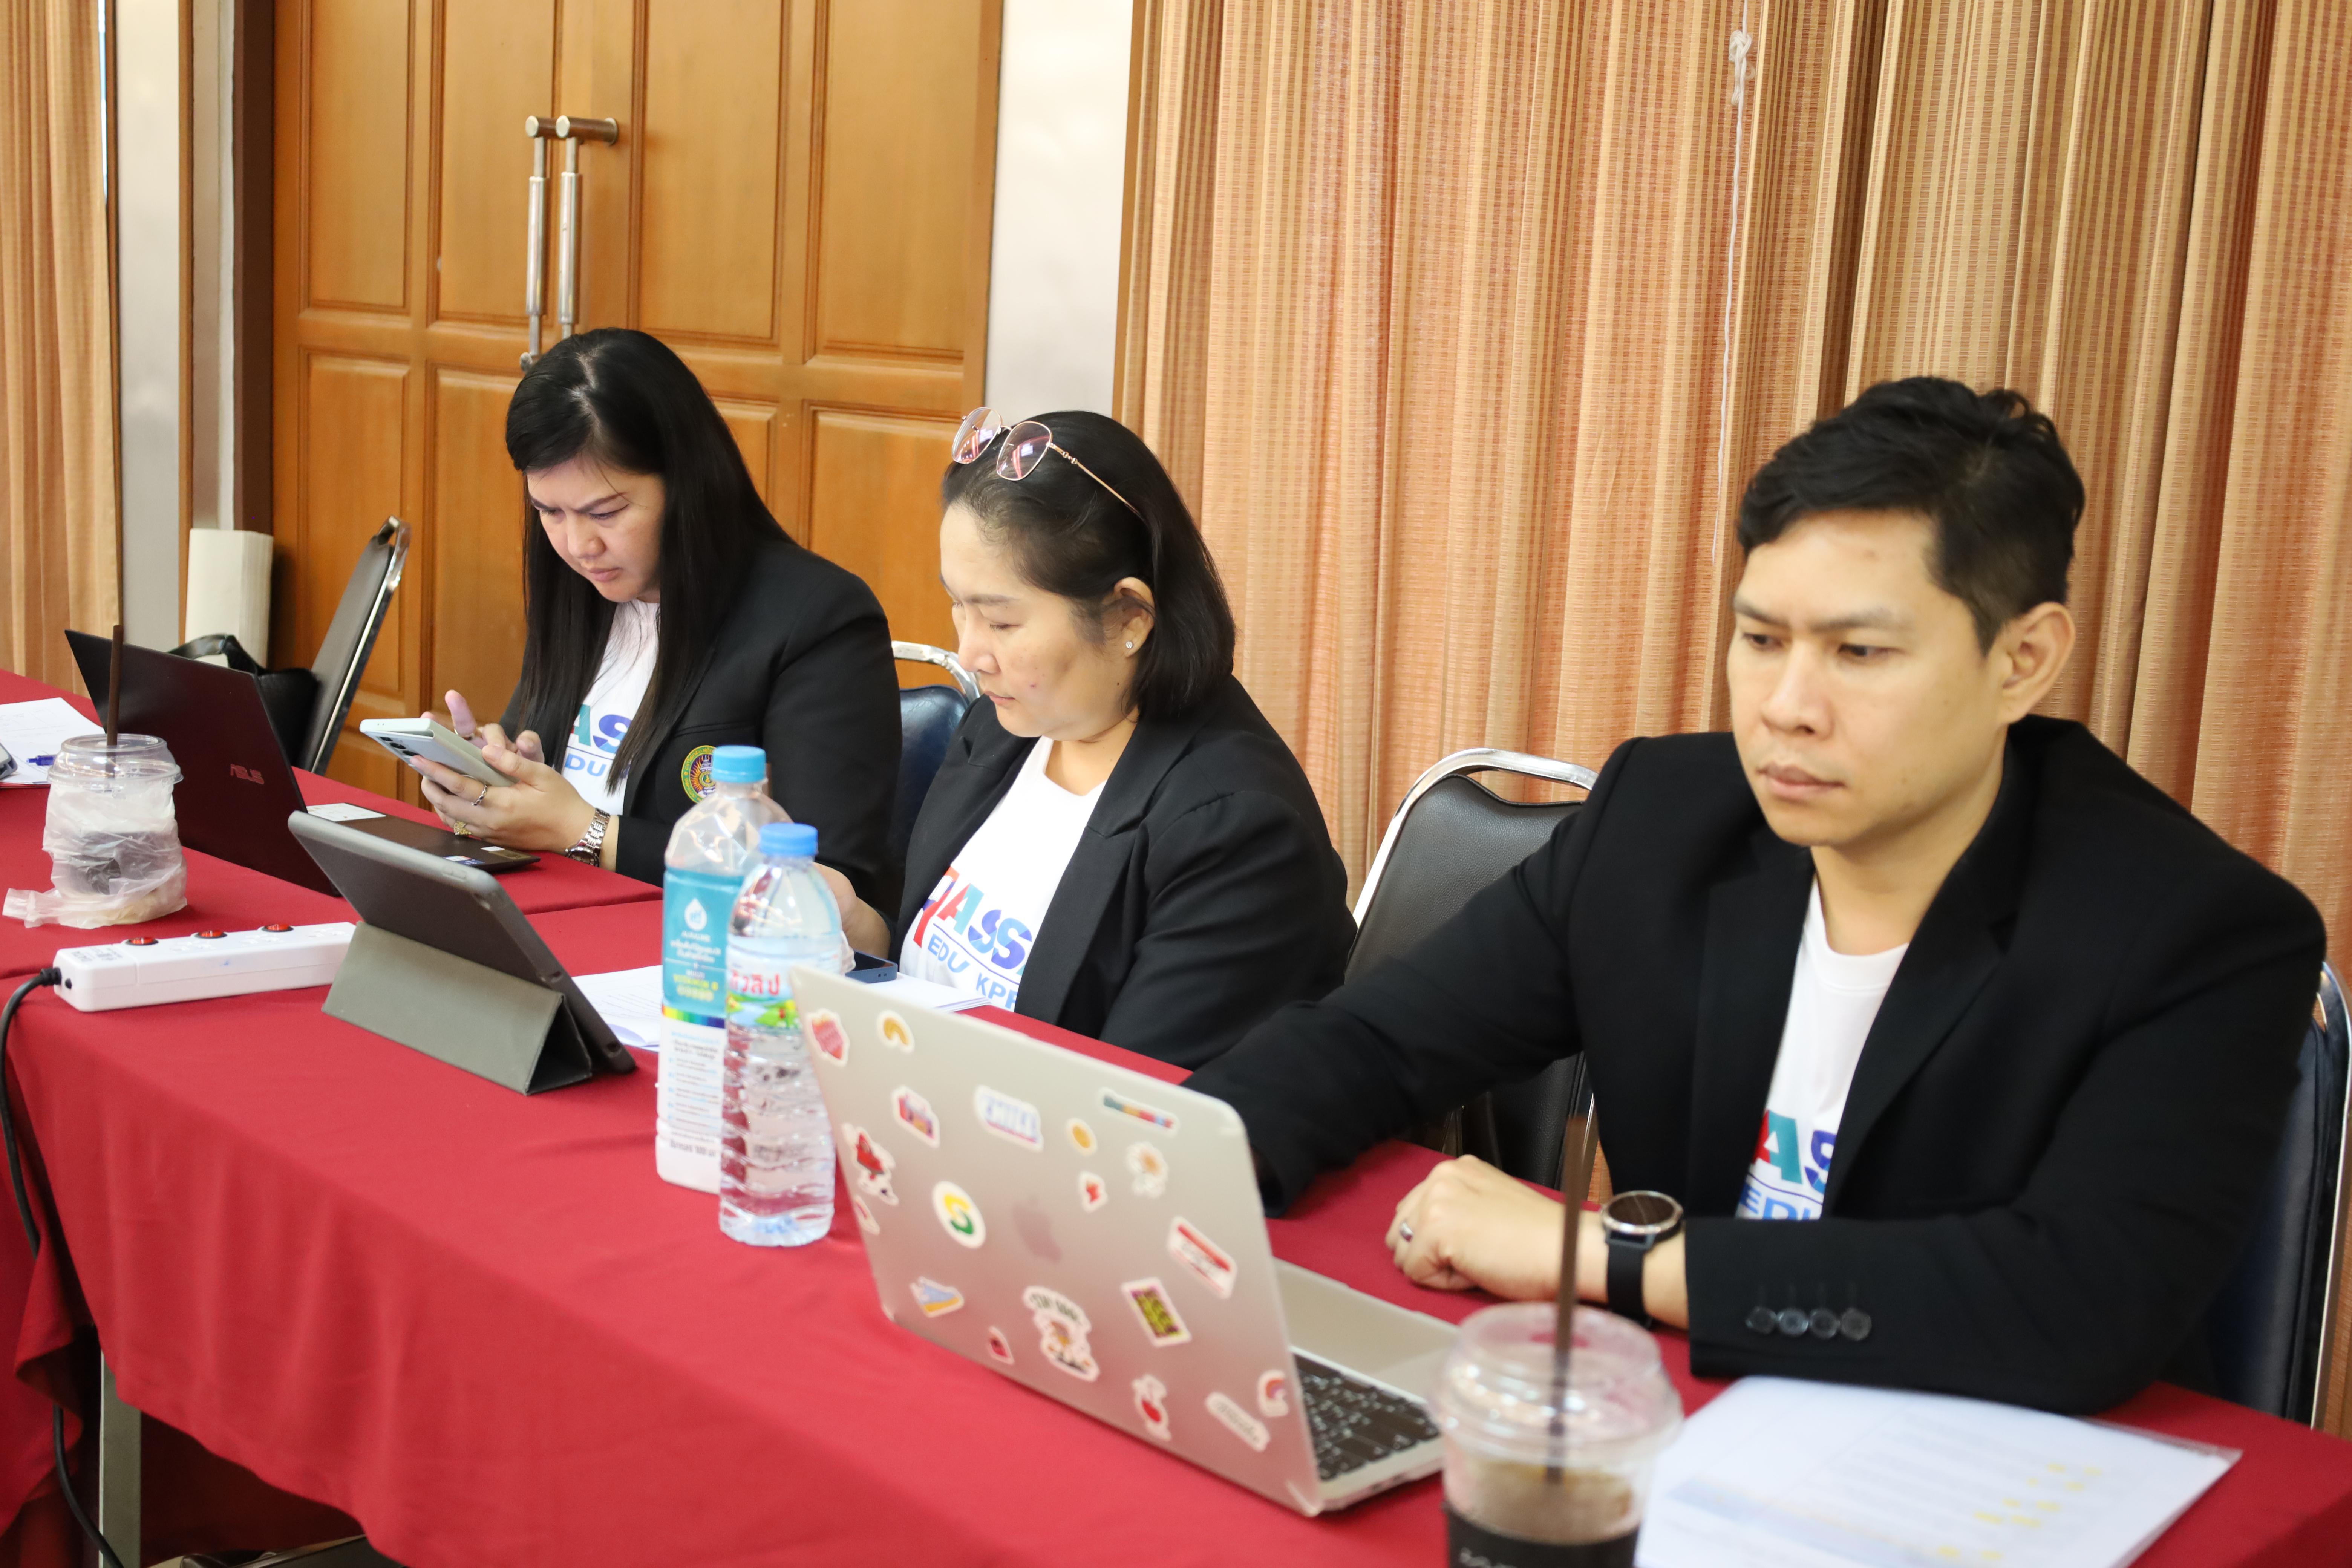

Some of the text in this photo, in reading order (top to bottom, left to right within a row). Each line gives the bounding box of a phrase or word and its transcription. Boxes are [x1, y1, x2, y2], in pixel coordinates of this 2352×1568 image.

[230, 763, 265, 784] ASUS
[913, 866, 1032, 975] ASS
[928, 933, 971, 973] EDU
